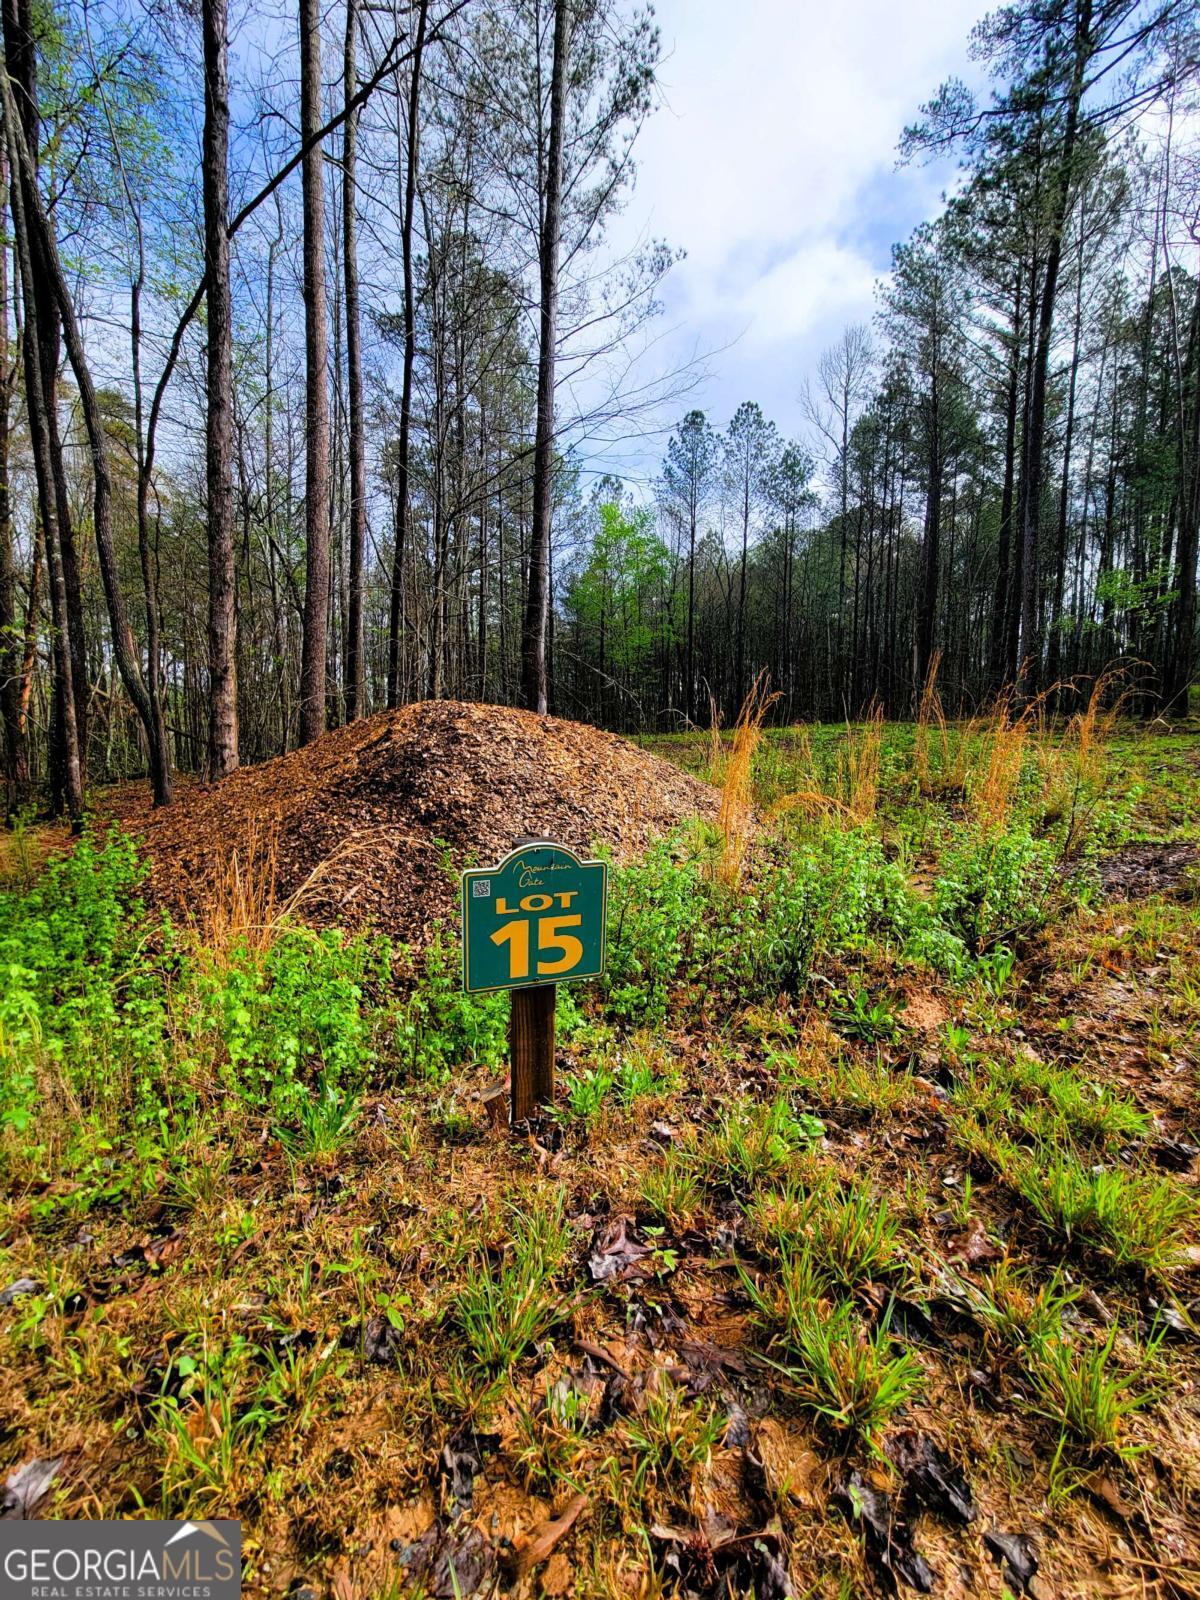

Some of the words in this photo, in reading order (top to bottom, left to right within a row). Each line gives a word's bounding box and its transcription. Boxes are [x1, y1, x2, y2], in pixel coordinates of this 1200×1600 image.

[512, 860, 572, 874] Mountain
[495, 891, 579, 915] LOT
[489, 913, 584, 979] 15
